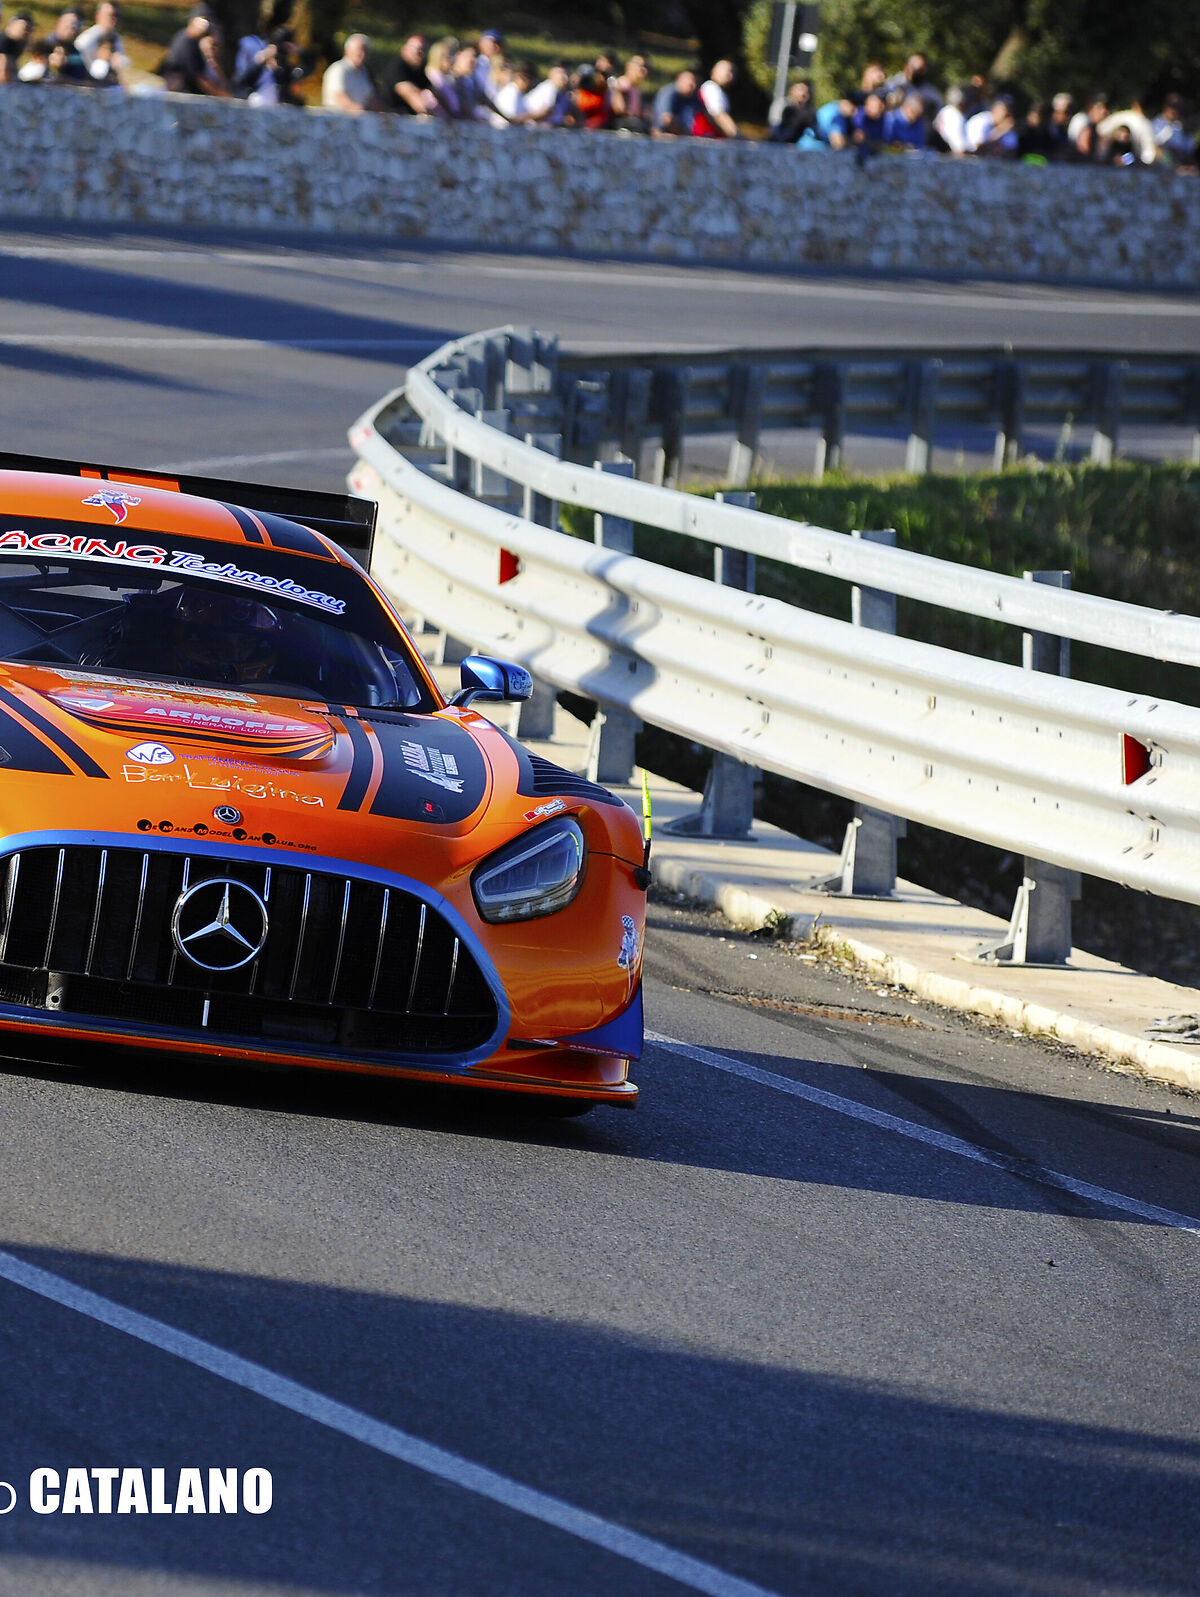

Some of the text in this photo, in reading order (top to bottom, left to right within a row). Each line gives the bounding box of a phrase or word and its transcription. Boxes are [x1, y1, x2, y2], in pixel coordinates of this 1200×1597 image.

[171, 550, 347, 613] Technology
[144, 707, 309, 731] ARMOFER
[241, 727, 271, 735] LUIGI
[179, 754, 259, 768] TRATTAMENTO
